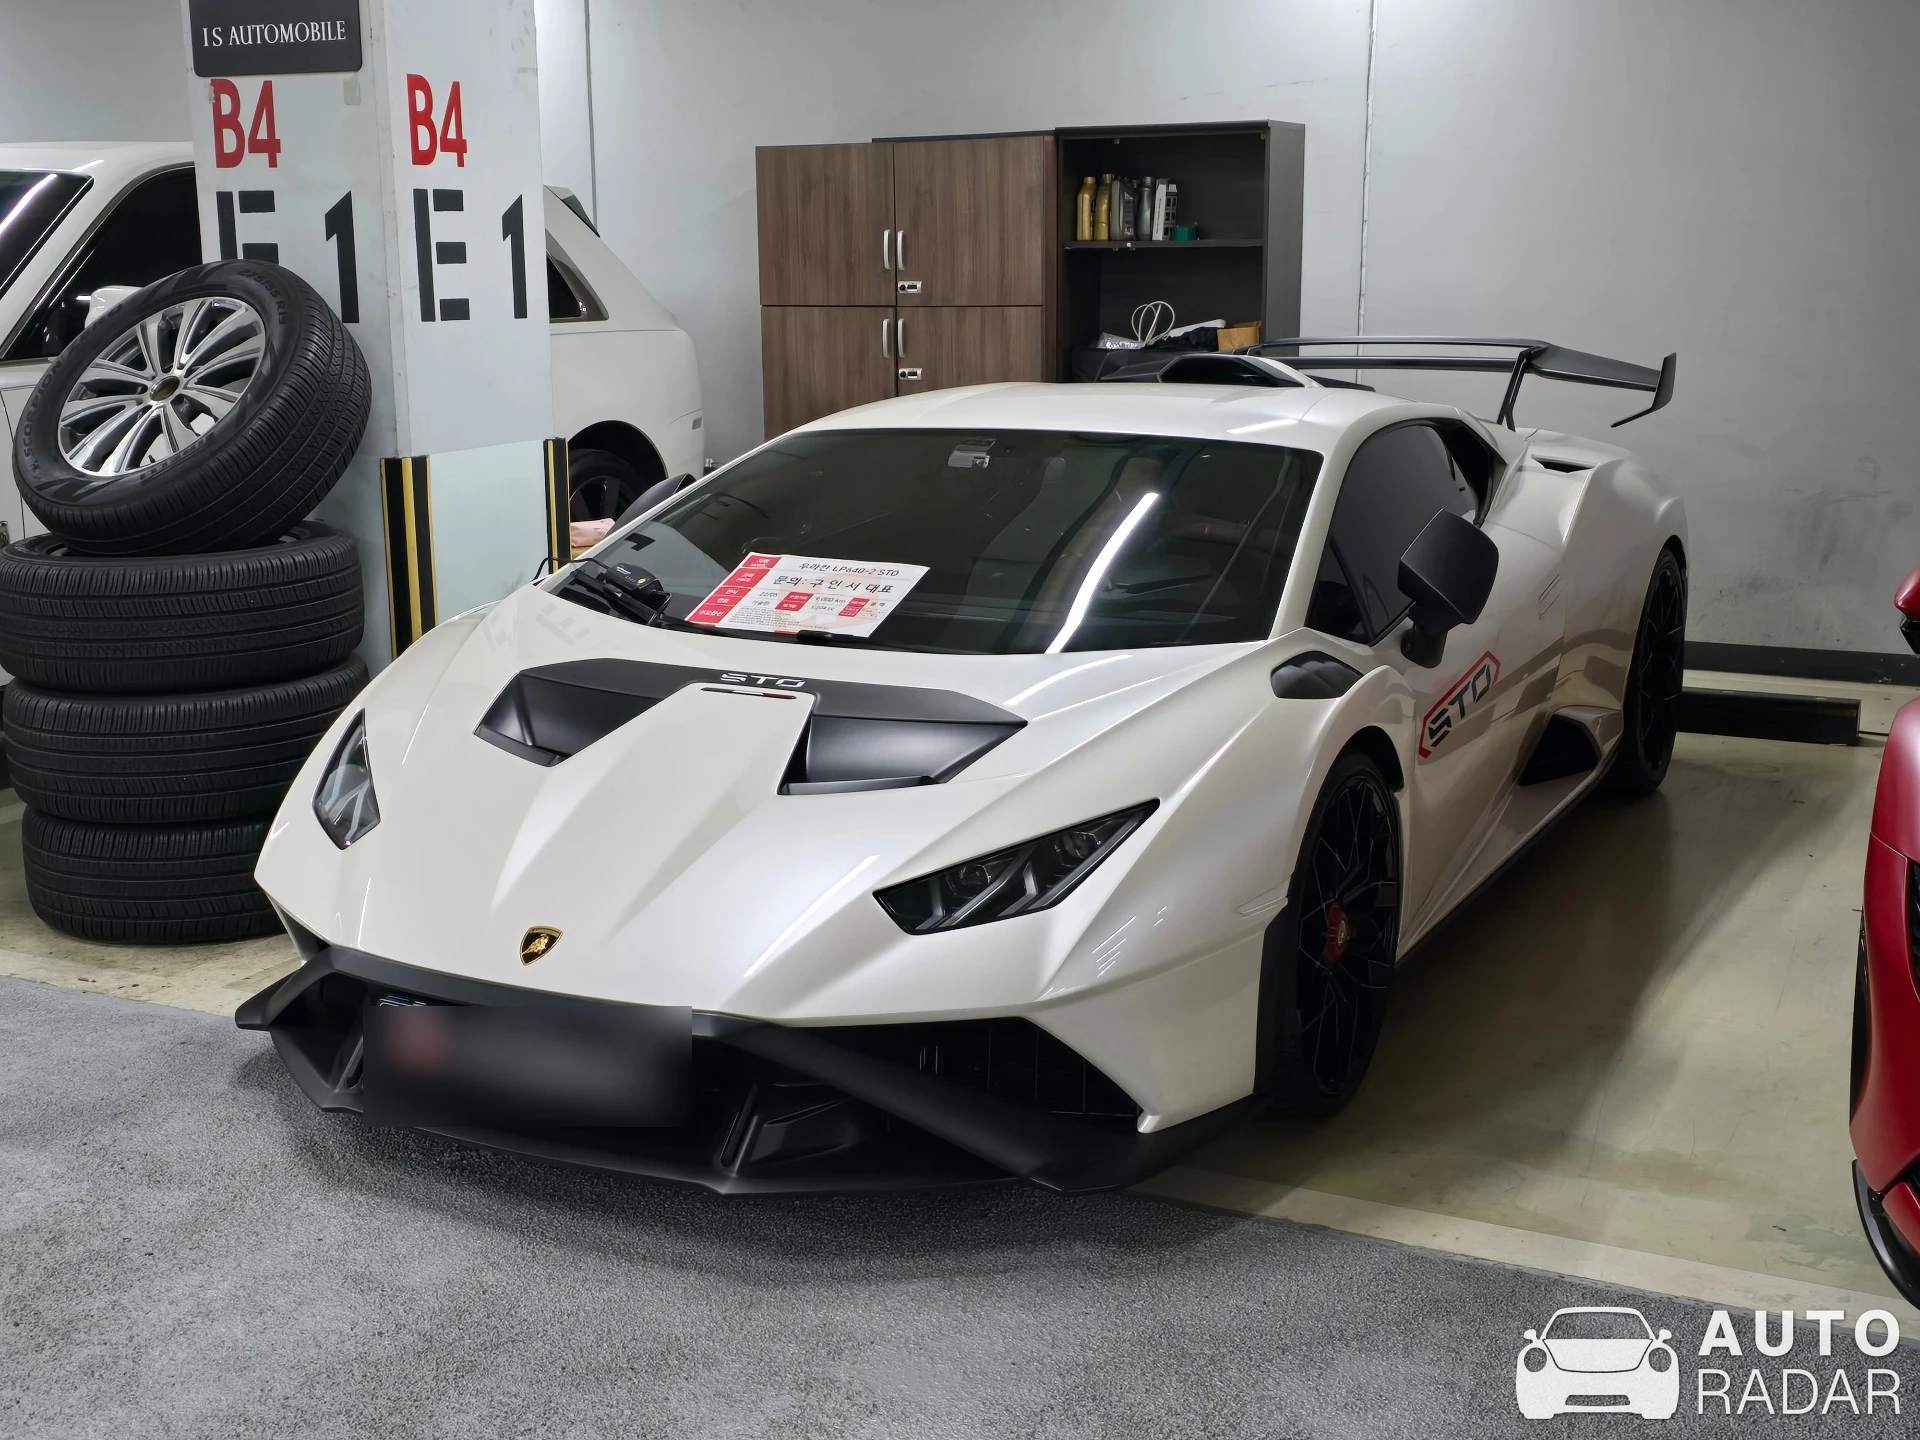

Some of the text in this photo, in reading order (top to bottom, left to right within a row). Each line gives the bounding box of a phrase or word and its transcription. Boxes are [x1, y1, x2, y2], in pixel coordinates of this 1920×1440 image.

[228, 20, 347, 46] AUTOMOBILE
[210, 78, 281, 168] B4
[406, 73, 467, 167] B4
[832, 566, 877, 575] LP640-2
[877, 569, 900, 577] STO
[865, 584, 894, 593] 대표
[721, 672, 806, 688] STO
[1427, 663, 1492, 748] STO
